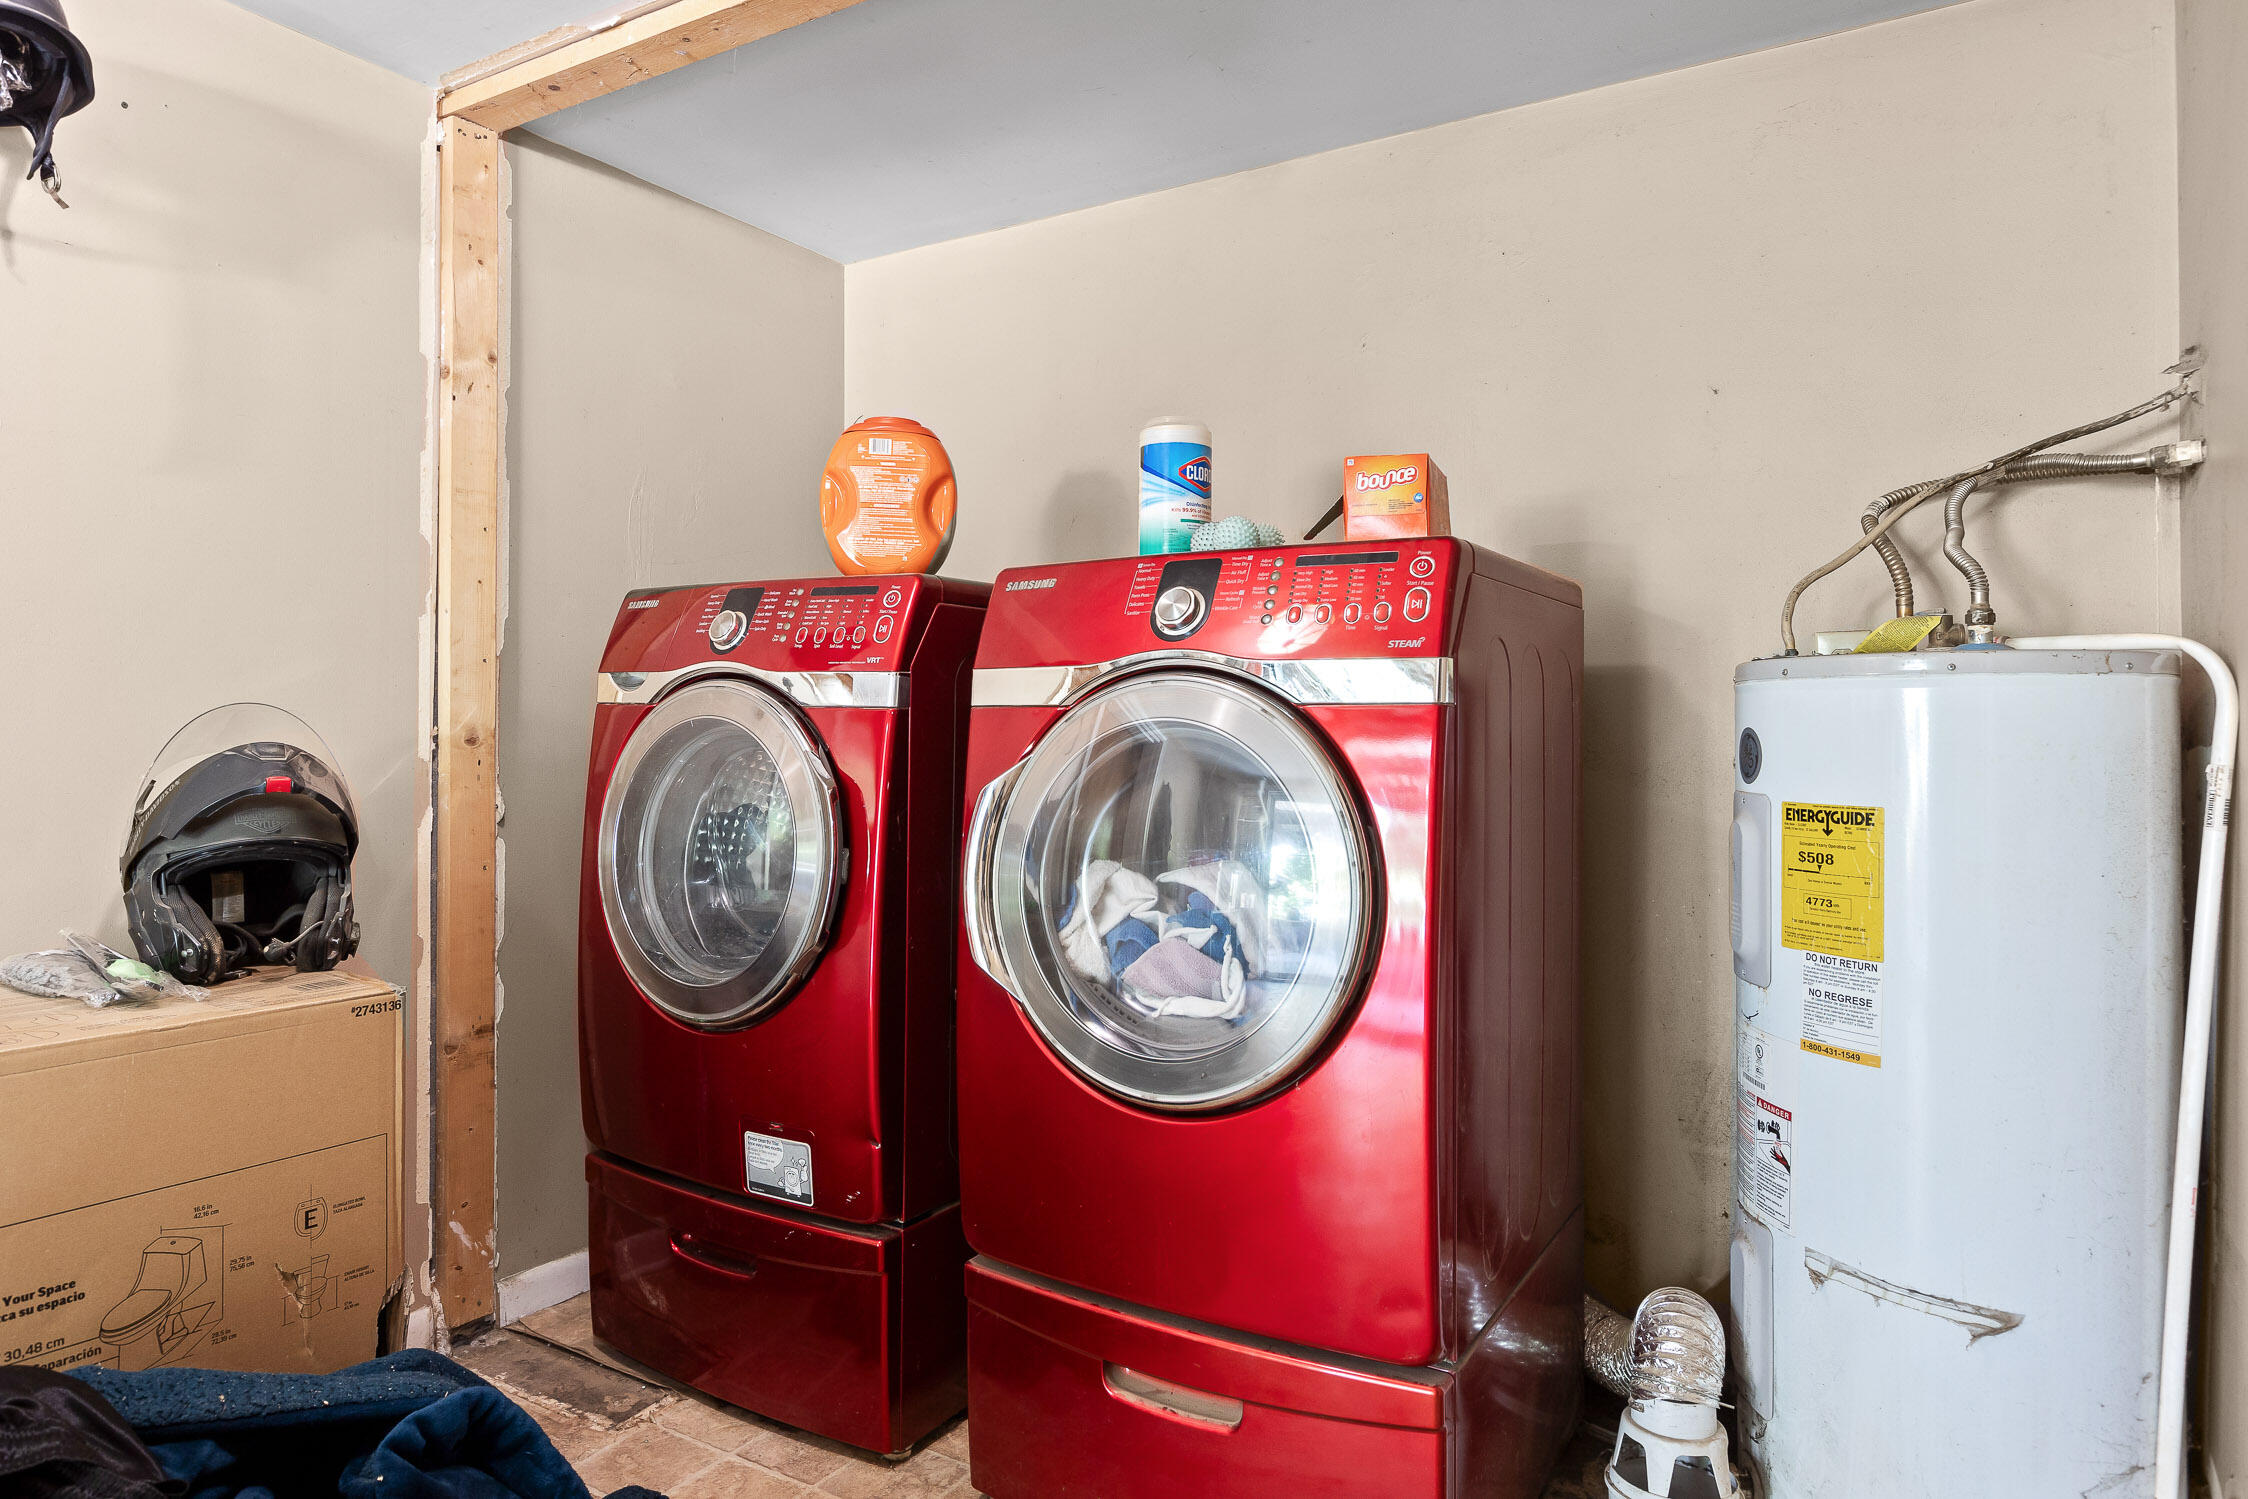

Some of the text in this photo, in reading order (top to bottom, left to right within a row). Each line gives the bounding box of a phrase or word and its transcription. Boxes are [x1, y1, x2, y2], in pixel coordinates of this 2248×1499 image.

[1186, 465, 1211, 483] CLOR
[1356, 466, 1417, 492] bounce
[1005, 578, 1057, 592] SAMSUNG
[1388, 640, 1421, 648] STEAM
[1798, 850, 1835, 866] $508
[1805, 897, 1833, 908] 4773
[1805, 952, 1878, 973] DO NOT RETURN
[1808, 988, 1873, 1008] NO REGRESE
[351, 1000, 402, 1017] #2743136
[1802, 1041, 1861, 1062] 1-800-431-1549
[1763, 1102, 1790, 1120] DANGER
[304, 1208, 318, 1230] E
[2, 1280, 76, 1307] Your Space
[0, 1291, 86, 1323] ca su espacio
[4, 1338, 65, 1363] 30,48 cm
